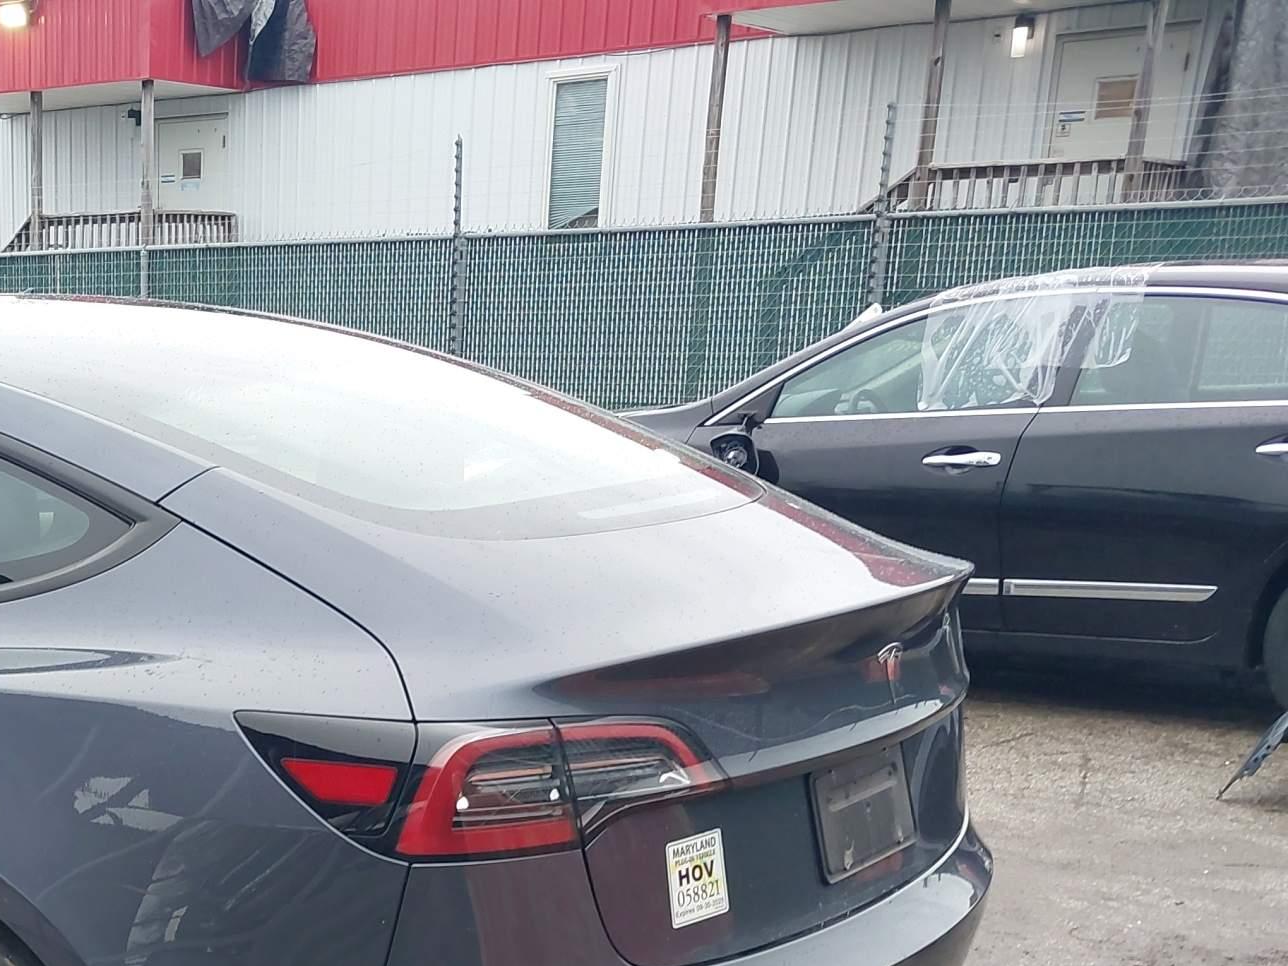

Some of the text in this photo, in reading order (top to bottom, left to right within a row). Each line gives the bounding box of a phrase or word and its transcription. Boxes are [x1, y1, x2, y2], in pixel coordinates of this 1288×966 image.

[672, 836, 716, 860] MARYLAND
[678, 860, 714, 887] HOV
[677, 879, 720, 908] 058821
